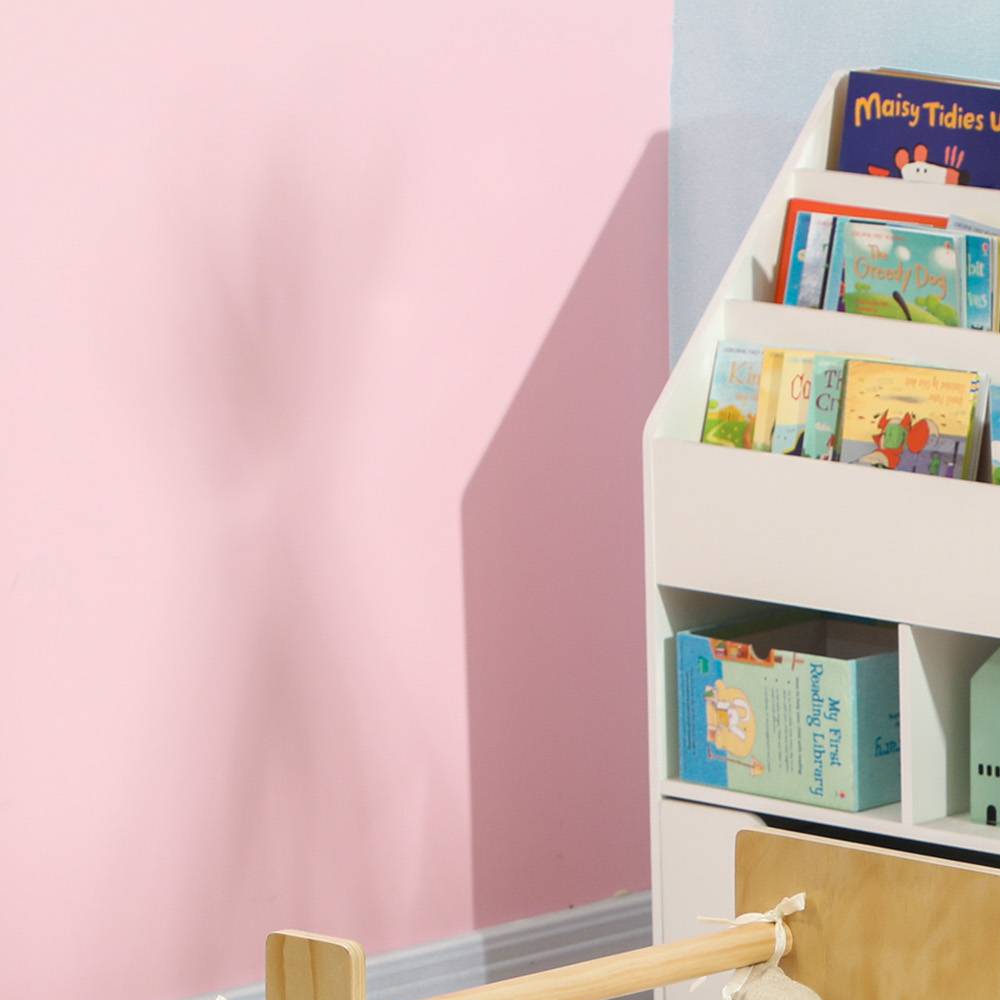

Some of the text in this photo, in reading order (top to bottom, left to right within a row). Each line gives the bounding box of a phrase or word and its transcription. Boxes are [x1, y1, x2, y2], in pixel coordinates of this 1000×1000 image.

[854, 91, 921, 128] Maisy
[922, 101, 985, 132] Tidies
[853, 255, 913, 293] Greedy
[915, 262, 948, 302] Dog
[806, 662, 826, 797] Reading Library
[824, 697, 843, 767] My First
